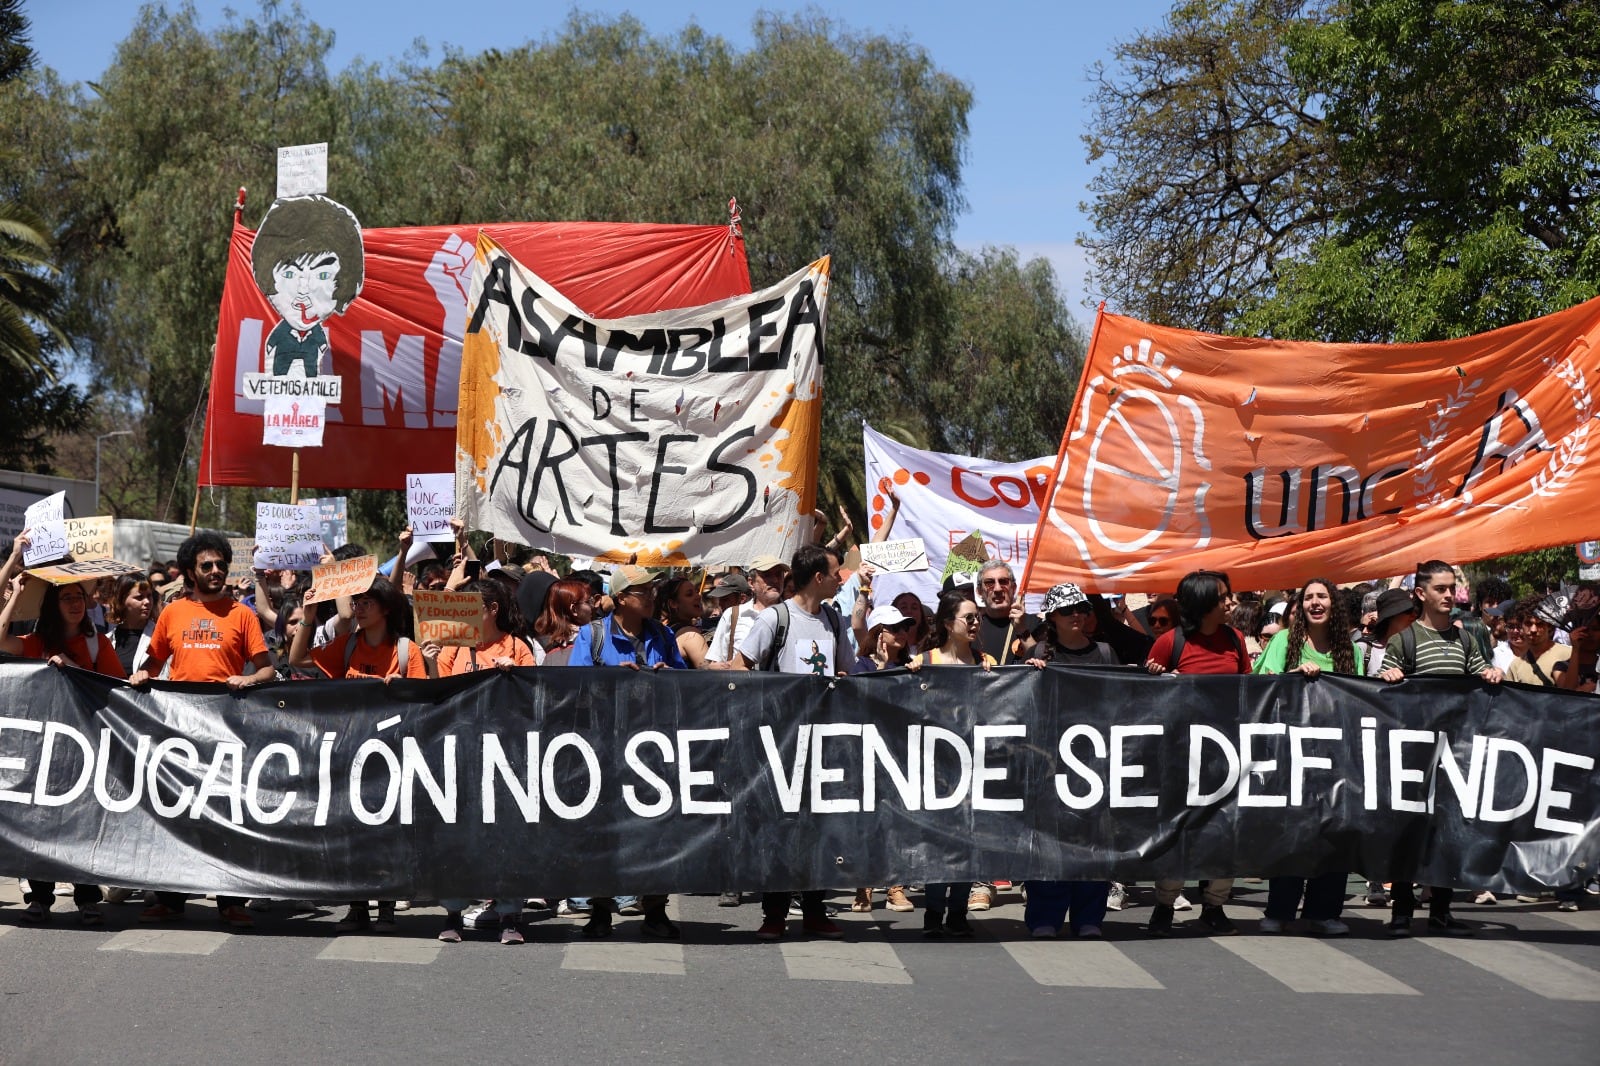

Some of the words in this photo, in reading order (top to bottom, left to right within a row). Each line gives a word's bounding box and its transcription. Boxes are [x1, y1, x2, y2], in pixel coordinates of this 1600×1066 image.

[466, 255, 824, 377] ASAMBLEA
[592, 386, 650, 421] DE
[267, 414, 280, 427] LA
[282, 407, 319, 428] MAREA
[410, 477, 422, 489] LA
[489, 416, 758, 537] ARTES
[414, 491, 440, 505] UNC
[258, 505, 270, 517] LOS
[272, 506, 304, 521] DOLORES
[64, 521, 86, 531] DU
[423, 519, 449, 530] VIDA
[25, 537, 66, 560] FUTURO
[68, 539, 109, 555] UBLICA
[418, 606, 425, 618] Y
[0, 715, 457, 826] EDUCACIÓN
[481, 731, 601, 824] NO
[621, 727, 732, 818] SE
[758, 723, 1027, 813] VENDE
[1054, 723, 1164, 810] SE
